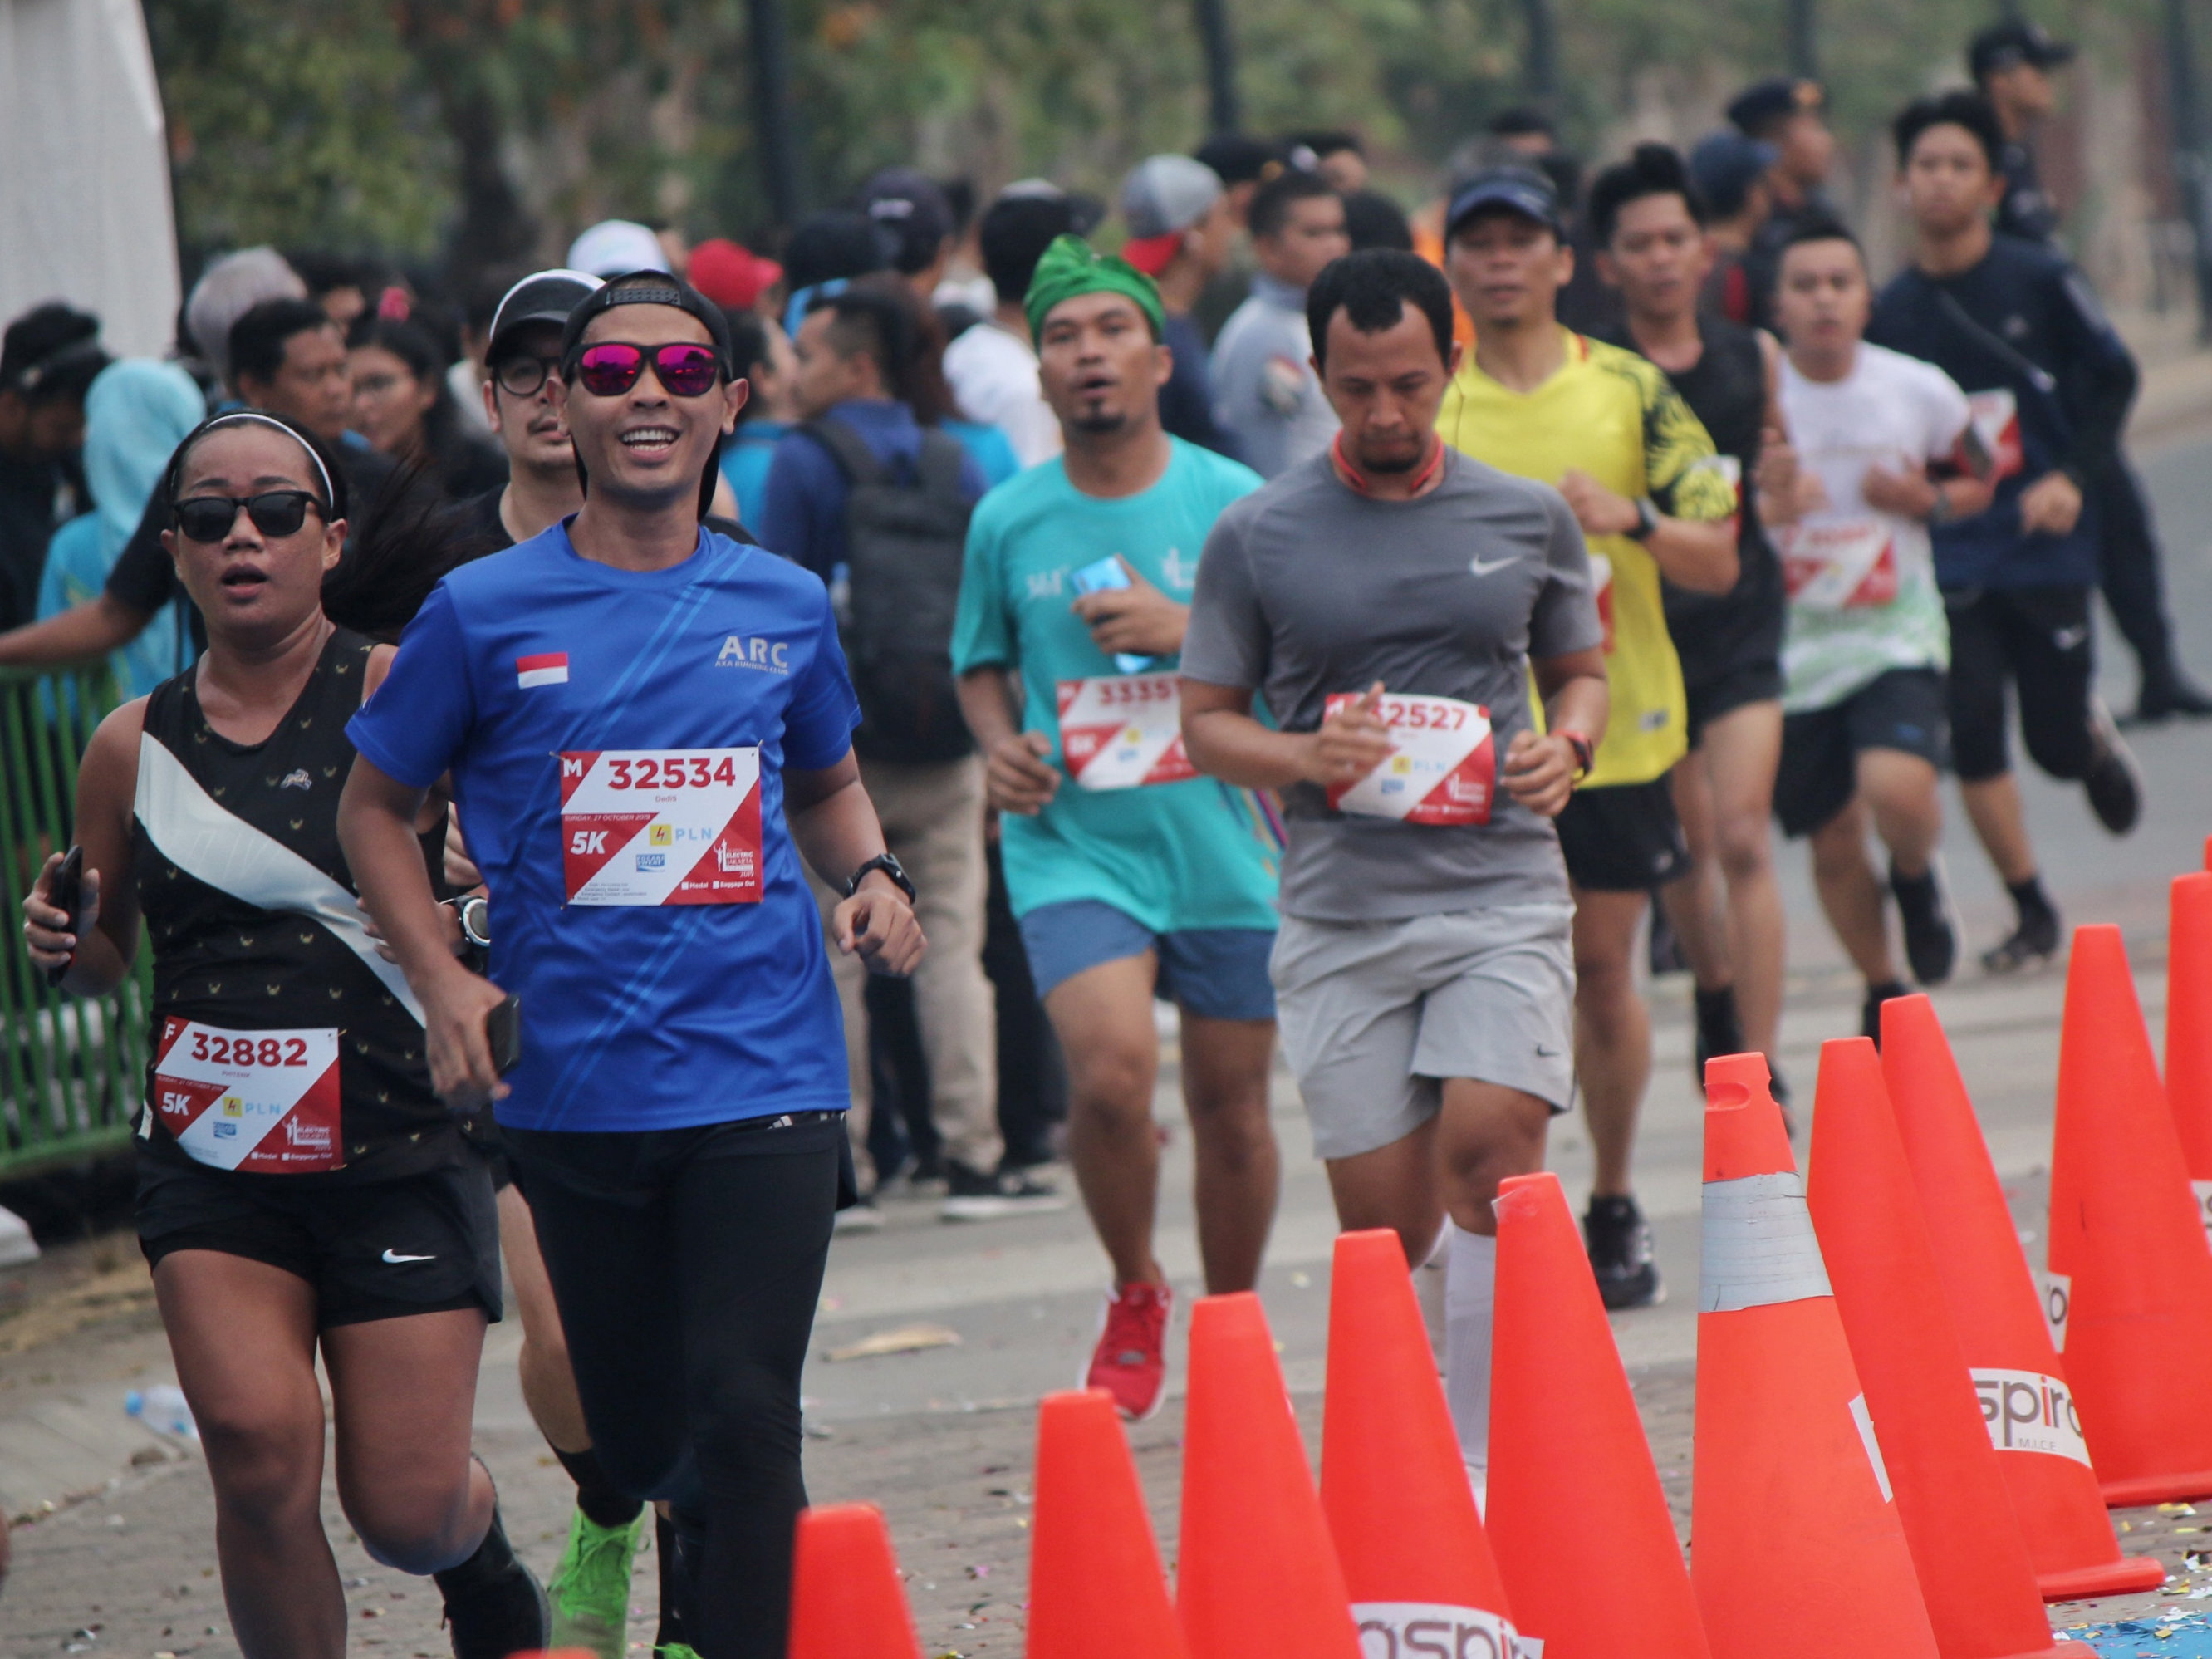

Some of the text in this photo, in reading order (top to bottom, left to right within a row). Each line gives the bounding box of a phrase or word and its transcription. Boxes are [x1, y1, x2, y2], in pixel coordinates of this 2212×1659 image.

[717, 635, 789, 669] ARC
[714, 660, 733, 668] AXA
[562, 758, 583, 778] M
[607, 757, 736, 790] 32534
[602, 813, 635, 822] OCTOBER
[675, 827, 713, 842] PLN
[570, 830, 609, 856] 5K
[726, 851, 754, 859] ELECTRIC
[689, 881, 709, 890] Medal
[164, 1023, 177, 1040] F
[190, 1030, 308, 1068] 32882
[160, 1092, 193, 1117] 5K
[245, 1102, 282, 1116] PLN
[2018, 1437, 2058, 1451] M.I.C.E
